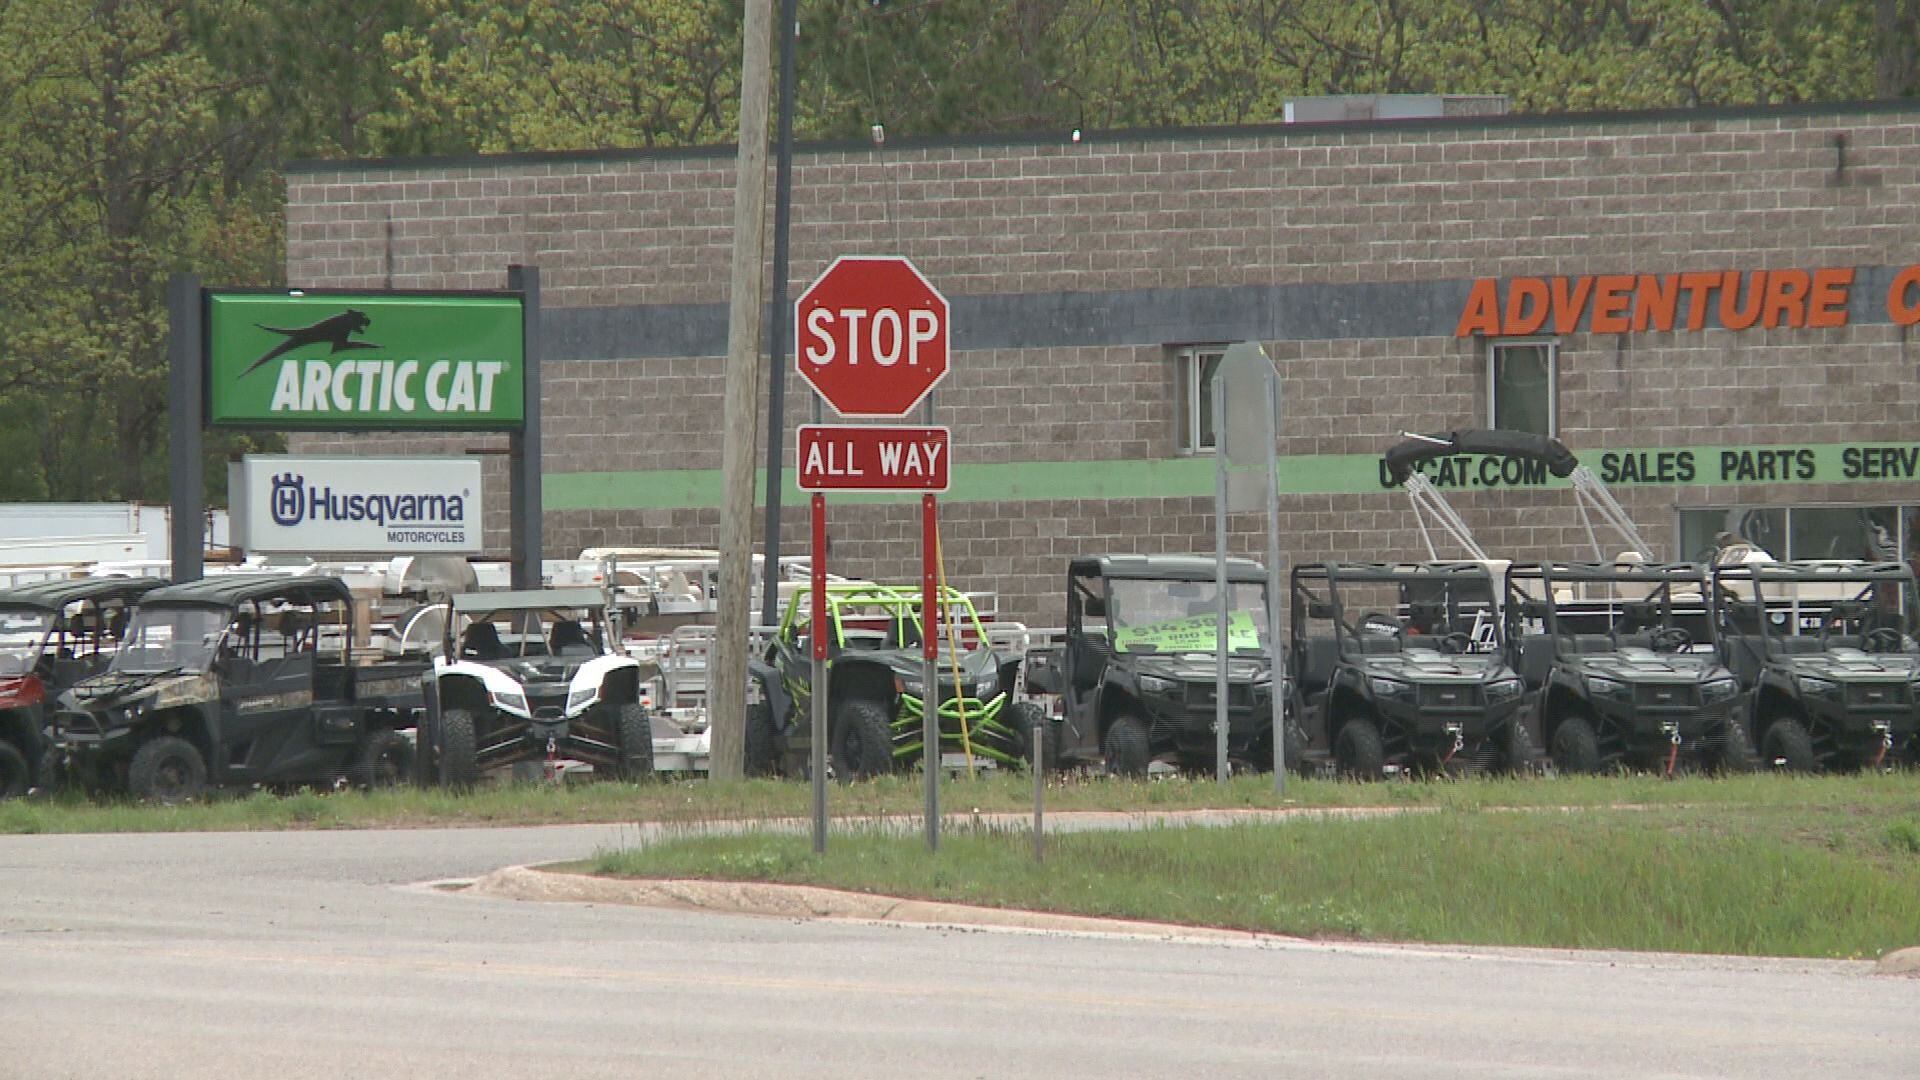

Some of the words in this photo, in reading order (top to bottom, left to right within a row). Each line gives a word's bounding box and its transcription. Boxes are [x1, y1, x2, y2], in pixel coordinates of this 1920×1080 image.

[1456, 267, 1855, 337] ADVENTURE
[805, 307, 939, 367] STOP
[270, 359, 419, 412] ARCTIC
[424, 359, 502, 412] CAT
[804, 441, 864, 476] ALL
[878, 441, 942, 476] WAY
[1379, 455, 1547, 489] UCAT.COM
[1601, 451, 1696, 484] SALES
[1721, 448, 1816, 481] PARTS
[1842, 447, 1920, 479] SERV
[309, 487, 465, 527] Husqvarna
[387, 531, 465, 543] MOTORCYCLES
